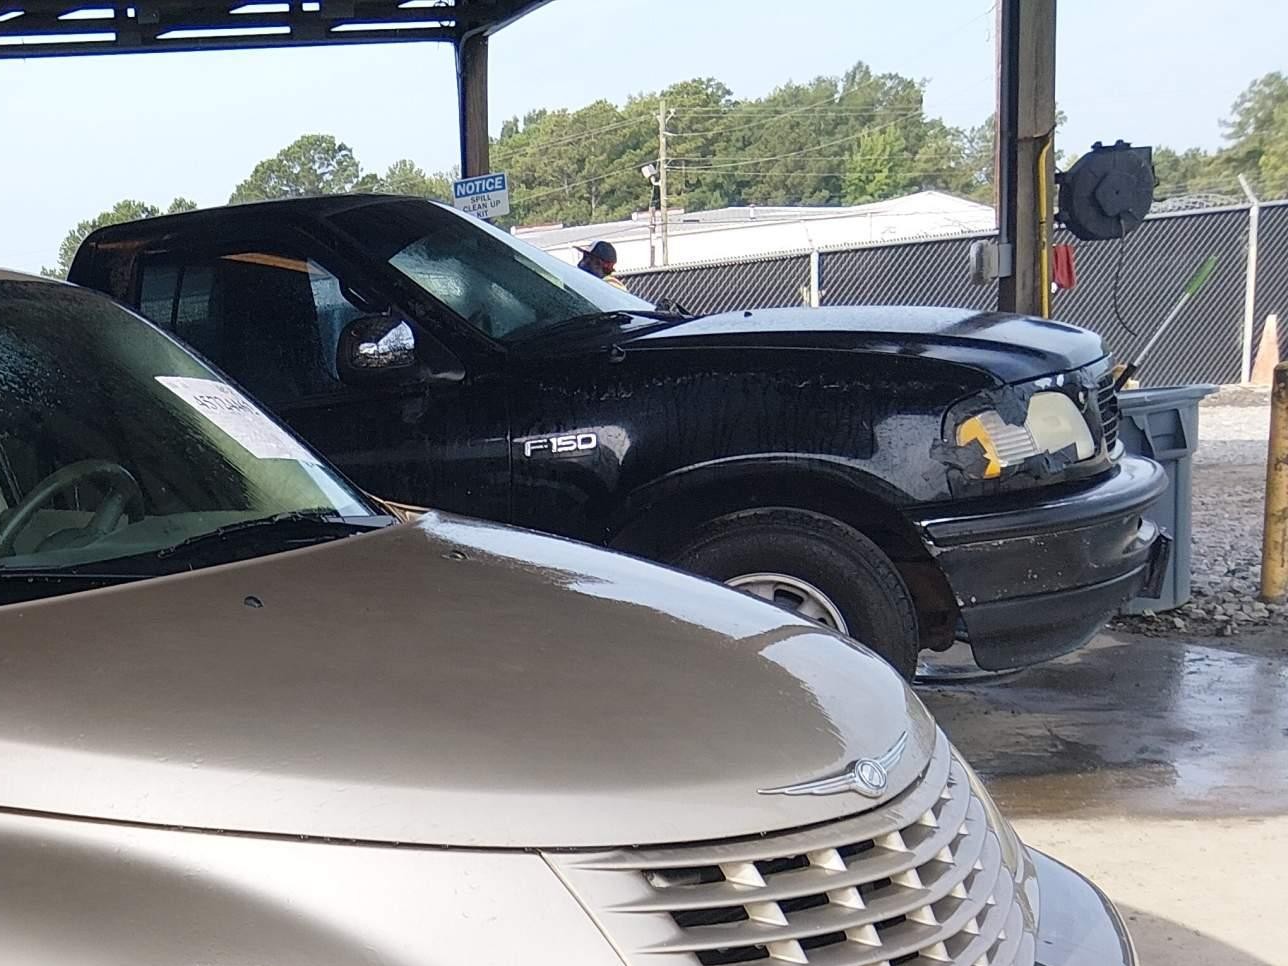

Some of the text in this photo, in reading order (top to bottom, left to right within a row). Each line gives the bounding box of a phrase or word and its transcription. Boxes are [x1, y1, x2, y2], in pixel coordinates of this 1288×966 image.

[456, 176, 503, 197] NOTICE
[470, 194, 492, 204] SPILL
[462, 200, 501, 213] CLEAN UP
[476, 210, 489, 218] KIT
